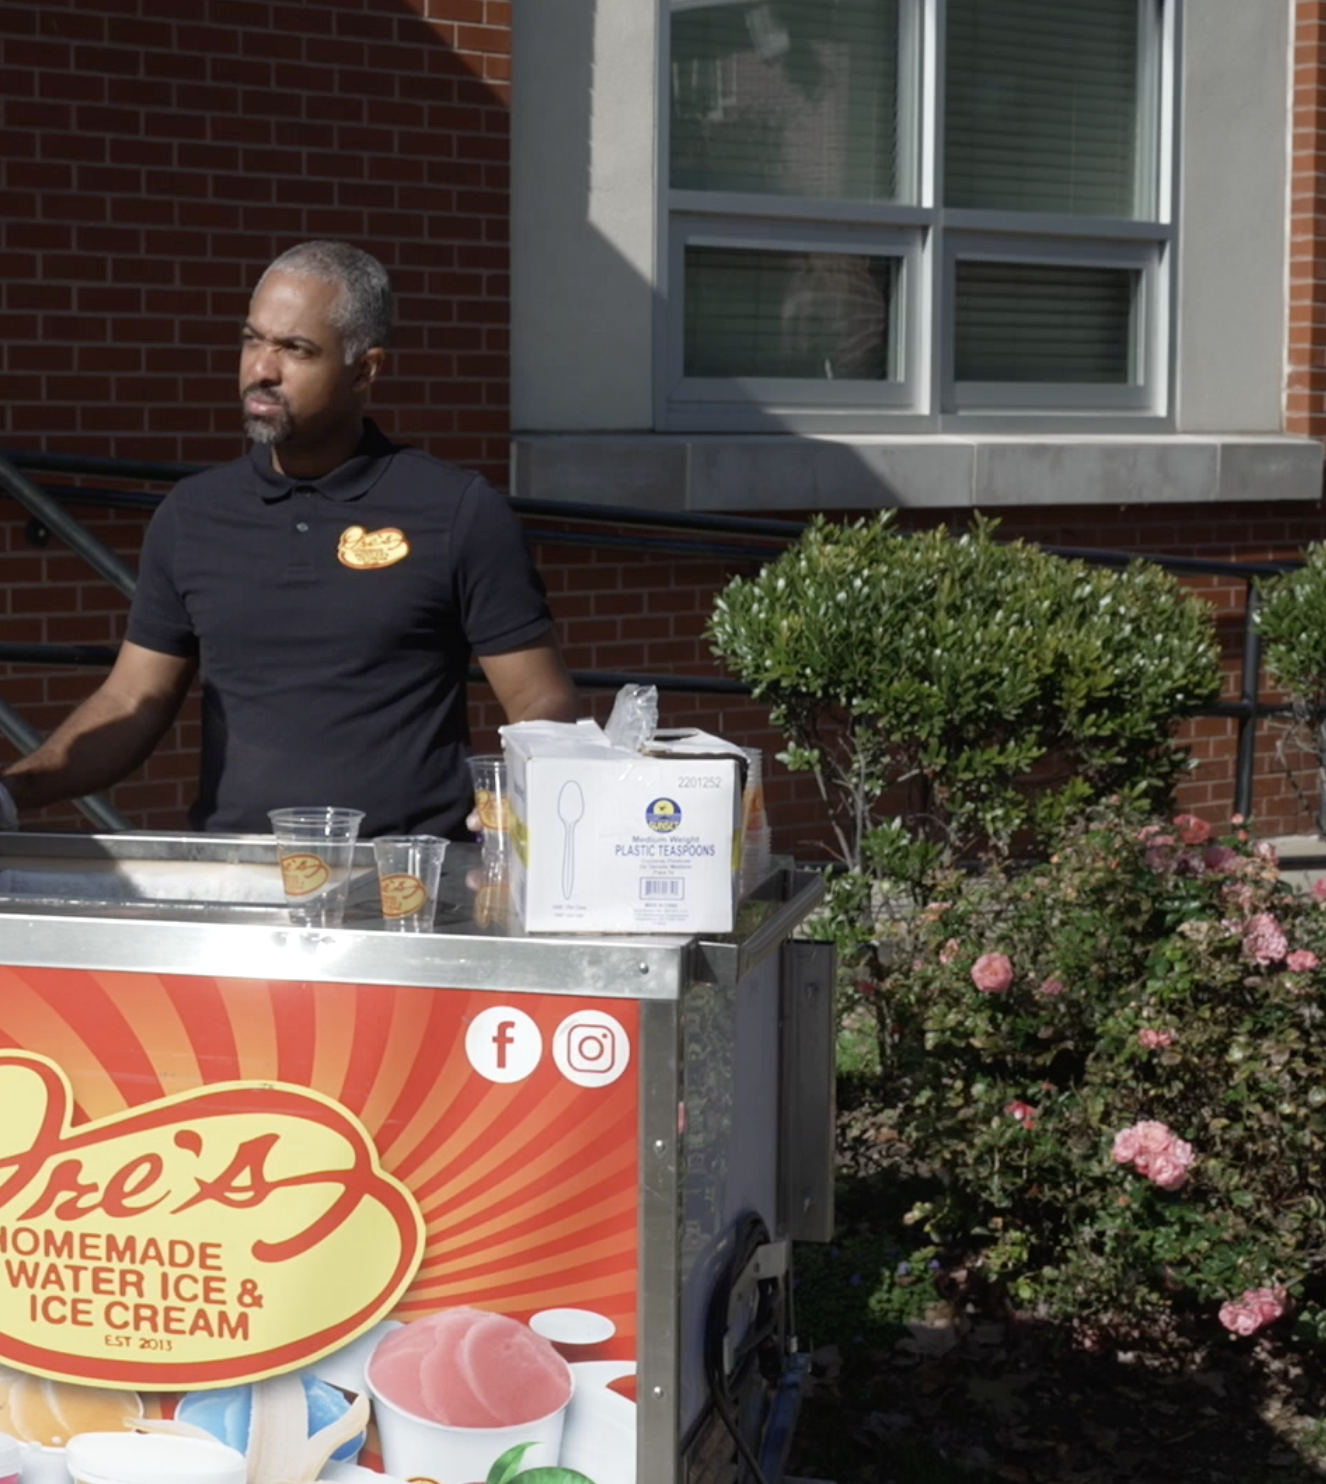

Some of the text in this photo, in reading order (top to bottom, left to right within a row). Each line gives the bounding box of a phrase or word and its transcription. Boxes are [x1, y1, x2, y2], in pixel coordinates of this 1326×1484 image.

[678, 776, 722, 788] 2201252
[669, 836, 700, 845] Weight
[615, 845, 716, 857] PLASTIC TEASPOONS
[5, 1259, 264, 1310] WATER ICE &
[29, 1294, 251, 1342] ICE CREAM
[103, 1334, 174, 1353] EST 2013
